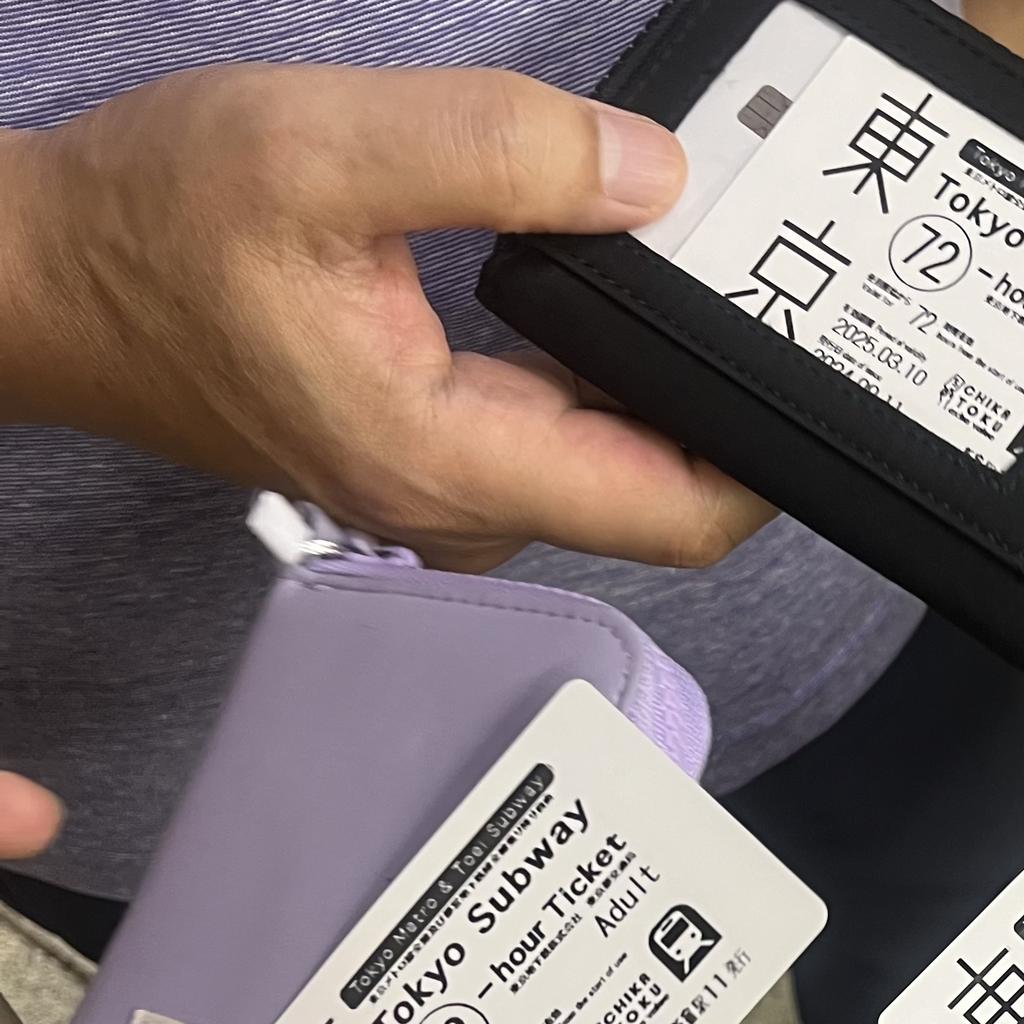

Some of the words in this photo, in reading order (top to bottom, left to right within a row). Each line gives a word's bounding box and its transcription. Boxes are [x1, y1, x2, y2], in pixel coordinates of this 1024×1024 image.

[901, 222, 961, 285] 72
[830, 316, 929, 387] 2025.03.10
[908, 303, 939, 336] 72
[956, 395, 1004, 433] TOKU
[963, 384, 1012, 422] CHIKA
[348, 948, 395, 994] Tokyo
[392, 897, 438, 945] Metro
[437, 879, 454, 895] &
[450, 841, 488, 876] Toei
[485, 775, 545, 839] Subway
[466, 798, 589, 935] Subway
[540, 833, 628, 919] Ticket
[593, 865, 661, 939] Adult
